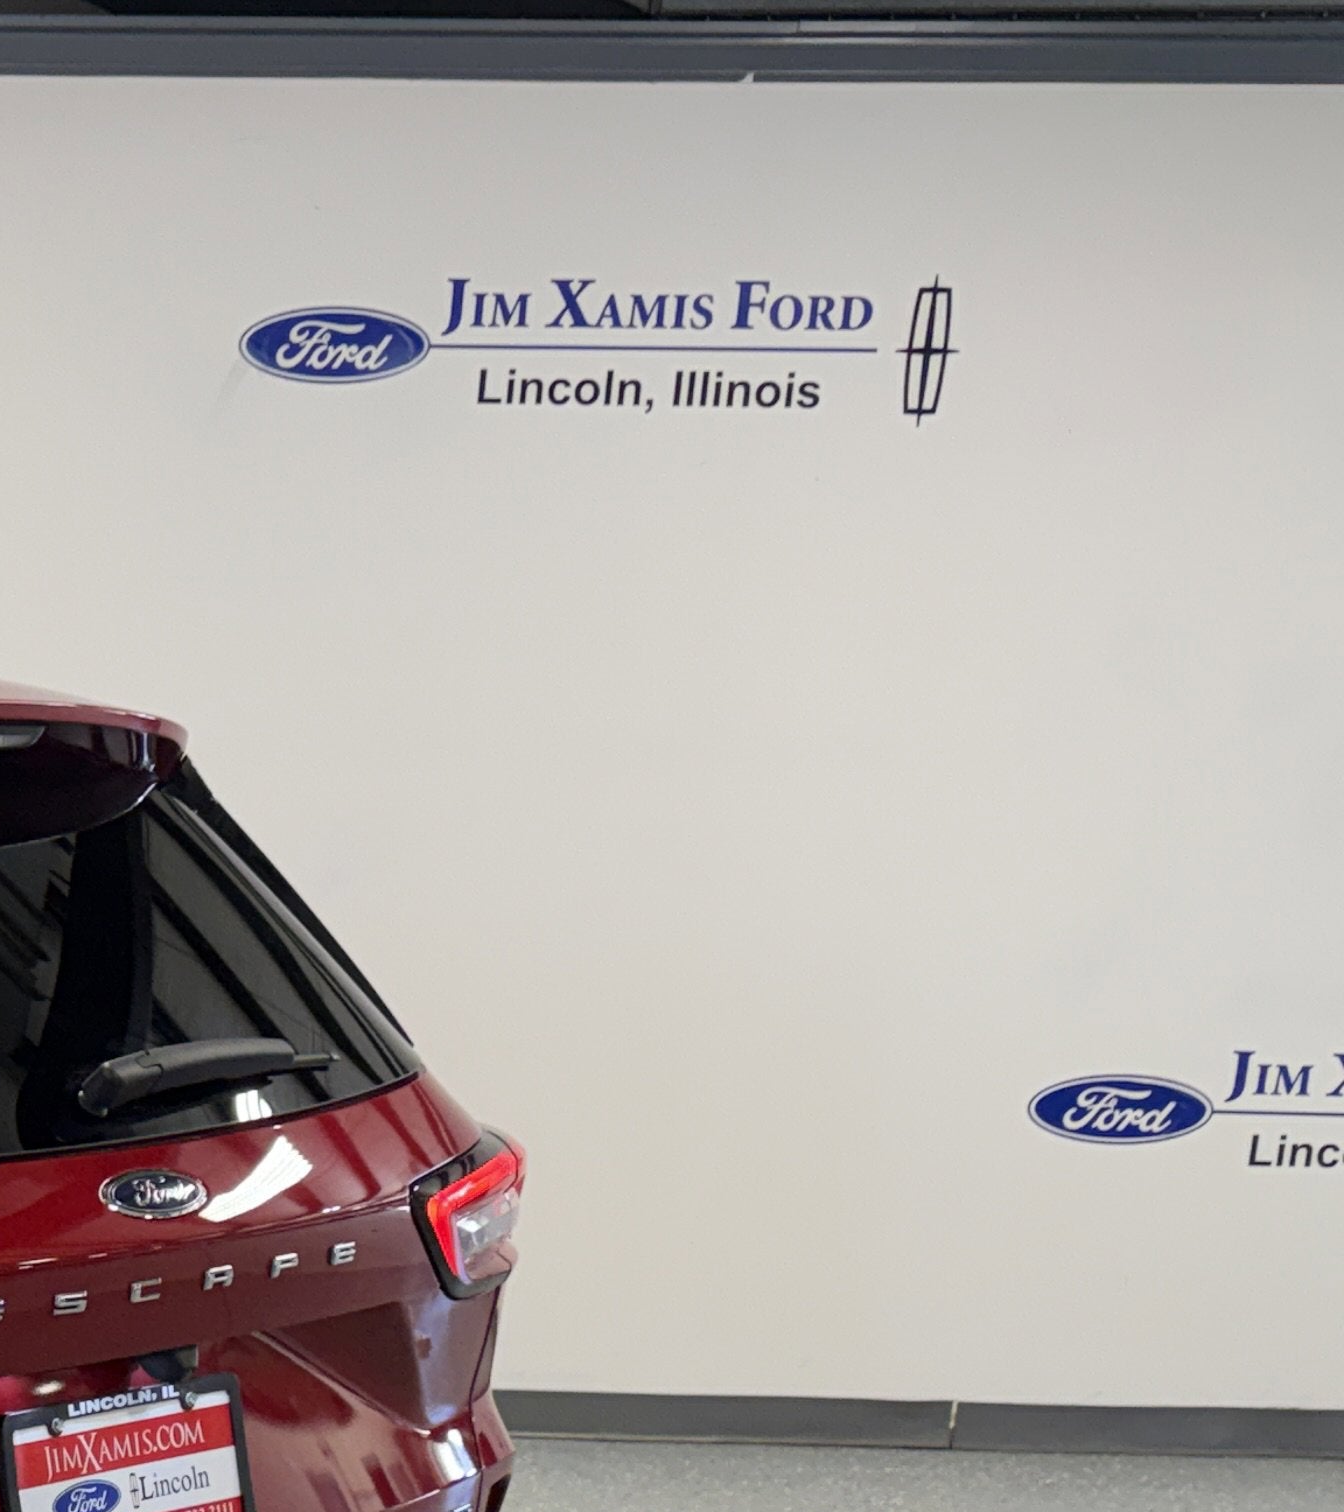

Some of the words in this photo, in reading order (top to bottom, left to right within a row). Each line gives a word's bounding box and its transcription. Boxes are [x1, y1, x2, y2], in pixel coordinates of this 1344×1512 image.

[442, 278, 532, 337] JIM
[546, 279, 714, 331] XAMIS
[732, 280, 875, 332] FORD
[274, 319, 390, 373] Ford
[476, 369, 654, 414] Lincoln,
[672, 371, 821, 409] Illinois
[1224, 1050, 1314, 1103] JIM
[1062, 1085, 1177, 1134] Ford
[1248, 1134, 1344, 1170] Linc
[68, 1389, 158, 1417] LINCOLN,
[162, 1384, 180, 1399] IL
[44, 1420, 205, 1483] JIMXAMIS.COM
[139, 1465, 210, 1500] Lincoln
